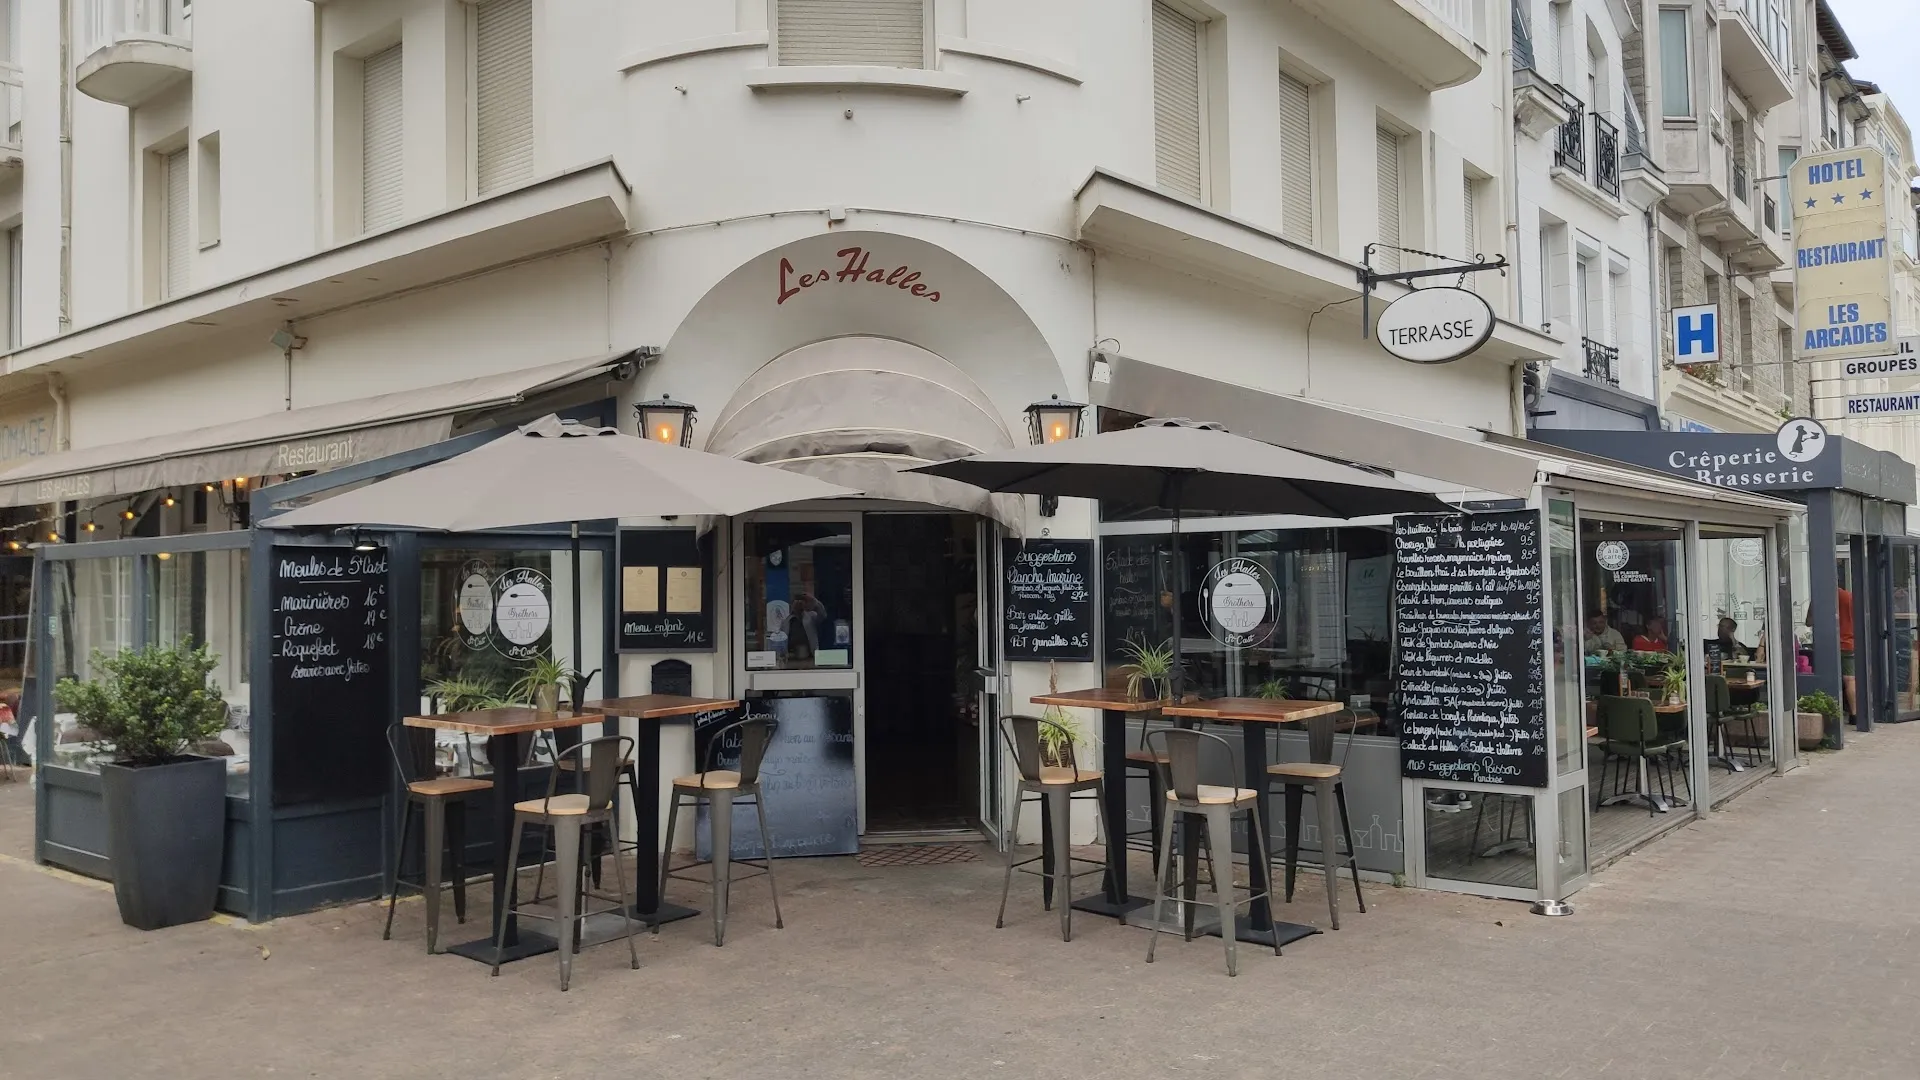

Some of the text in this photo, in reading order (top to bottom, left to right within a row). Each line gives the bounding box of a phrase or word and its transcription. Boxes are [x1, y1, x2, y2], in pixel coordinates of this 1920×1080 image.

[1808, 158, 1866, 185] HOTEL
[1797, 236, 1886, 269] RESTAURANT
[777, 246, 941, 305] Les Halles
[1828, 302, 1859, 325] LES
[1389, 319, 1474, 346] TERRASSE
[1677, 313, 1715, 355] H
[1804, 322, 1887, 350] ARCADES
[1846, 358, 1917, 375] GROUPES
[1848, 395, 1920, 414] RESTAURANT
[278, 435, 353, 468] Restaurant
[1668, 448, 1777, 472] Crêperie
[37, 475, 90, 499] LES HALLES
[1695, 466, 1814, 486] Brasserie
[1466, 536, 1505, 551] portugaise
[280, 555, 327, 578] Moules
[327, 556, 344, 577] de
[363, 554, 388, 575] Cast
[1213, 560, 1262, 581] Les Halles
[499, 570, 545, 591] Les Halles
[508, 608, 538, 619] Brothers
[1222, 596, 1255, 607] Brothers
[284, 616, 324, 637] Crème
[624, 618, 686, 637] Menu enfant
[282, 637, 340, 662] Roquefort
[325, 664, 346, 675] avec
[345, 658, 370, 682] frites
